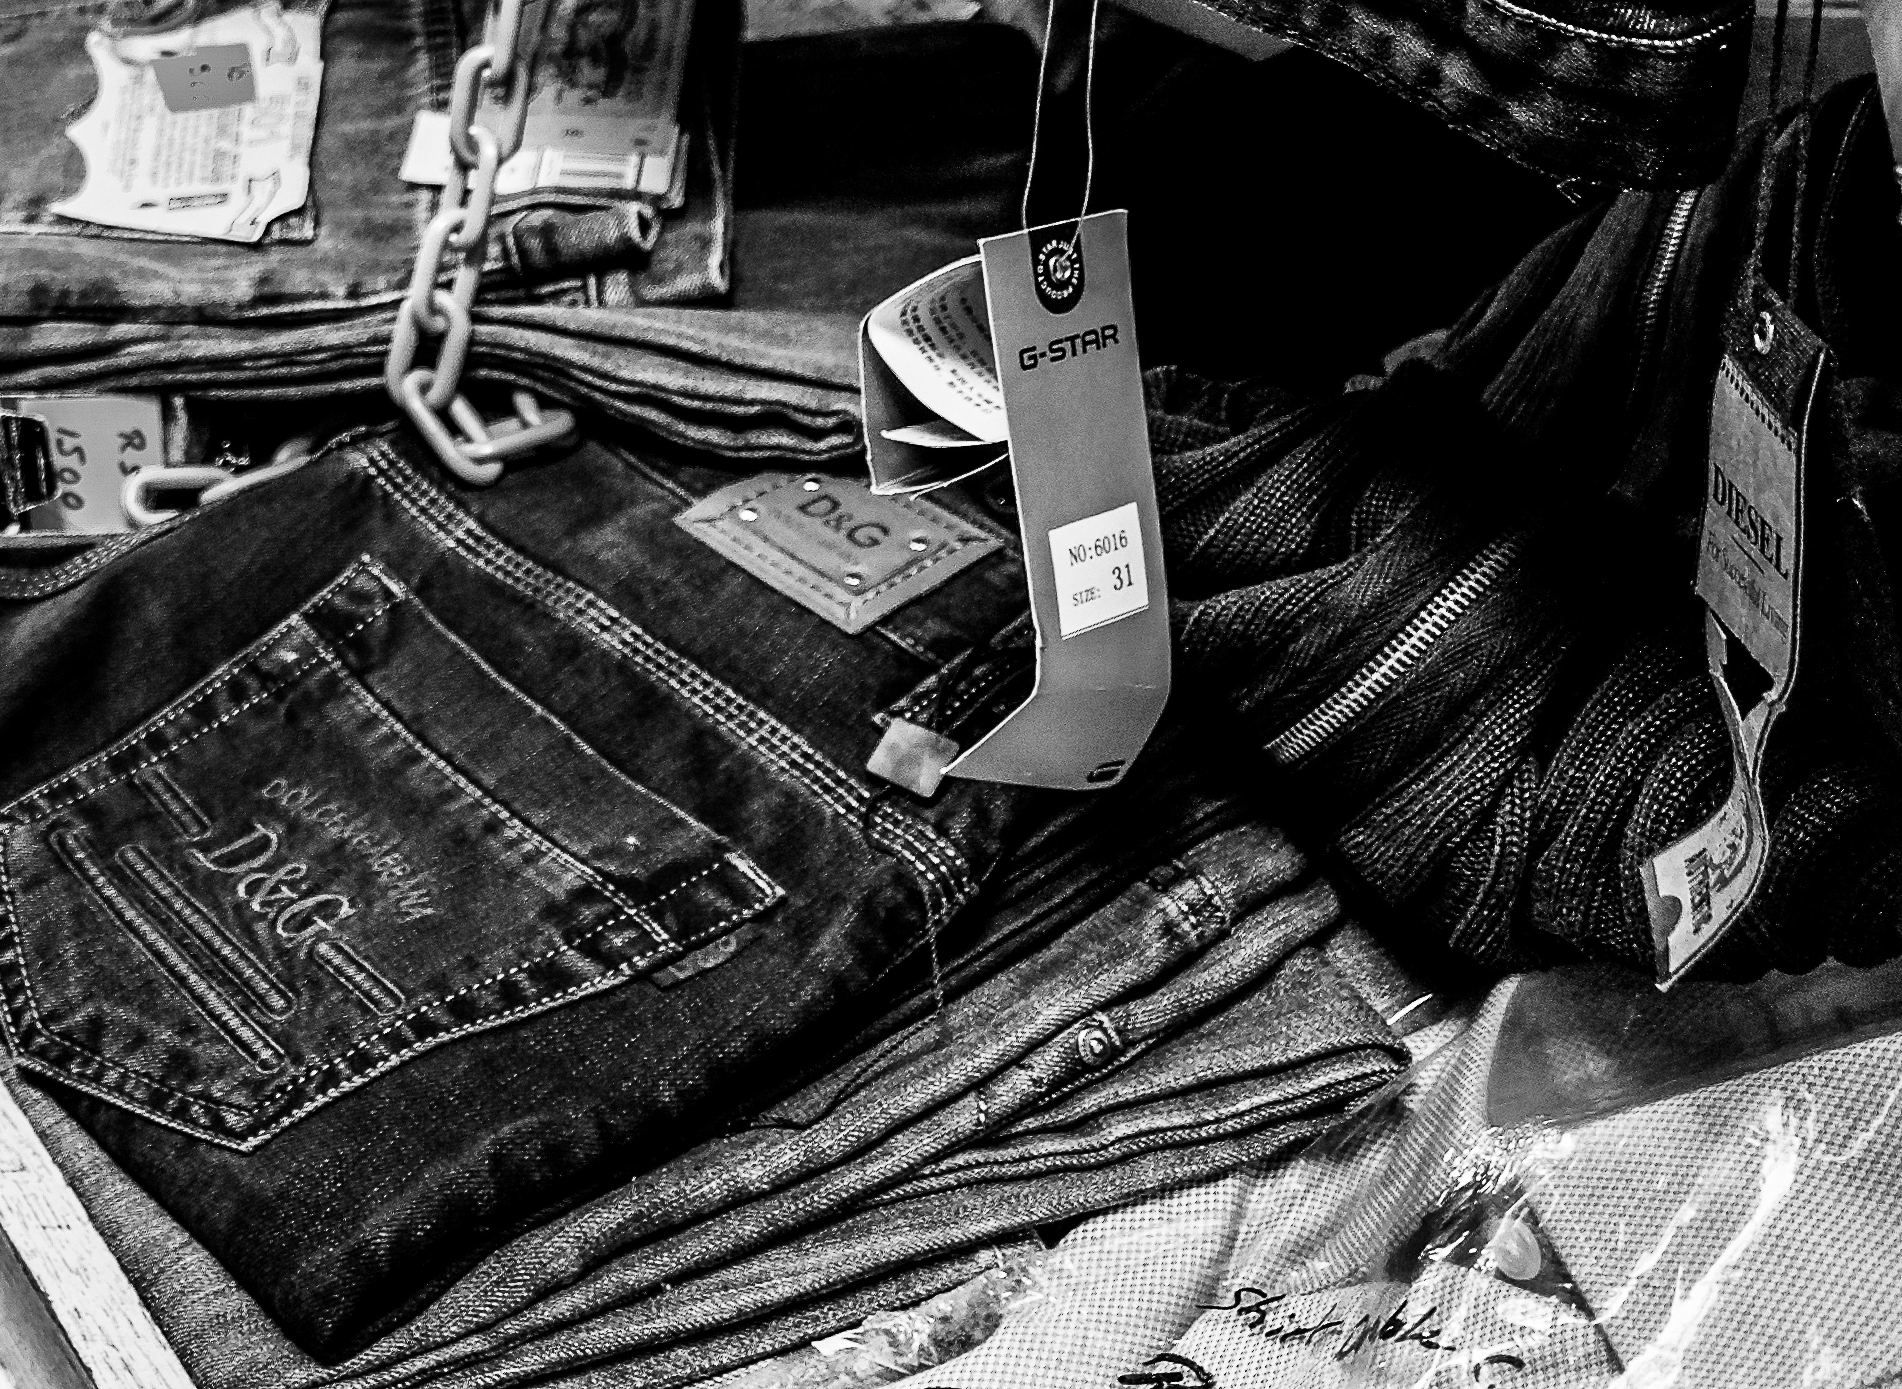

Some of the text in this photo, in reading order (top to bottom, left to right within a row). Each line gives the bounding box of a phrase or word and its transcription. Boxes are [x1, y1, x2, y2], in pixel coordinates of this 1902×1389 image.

[1018, 323, 1120, 371] G-STAR
[56, 426, 88, 512] 1500
[797, 492, 892, 550] D&G
[1068, 529, 1129, 567] NO:6016
[1712, 461, 1790, 582] DIESEL
[1072, 562, 1135, 607] SIZE: 31
[188, 818, 355, 939] D&G
